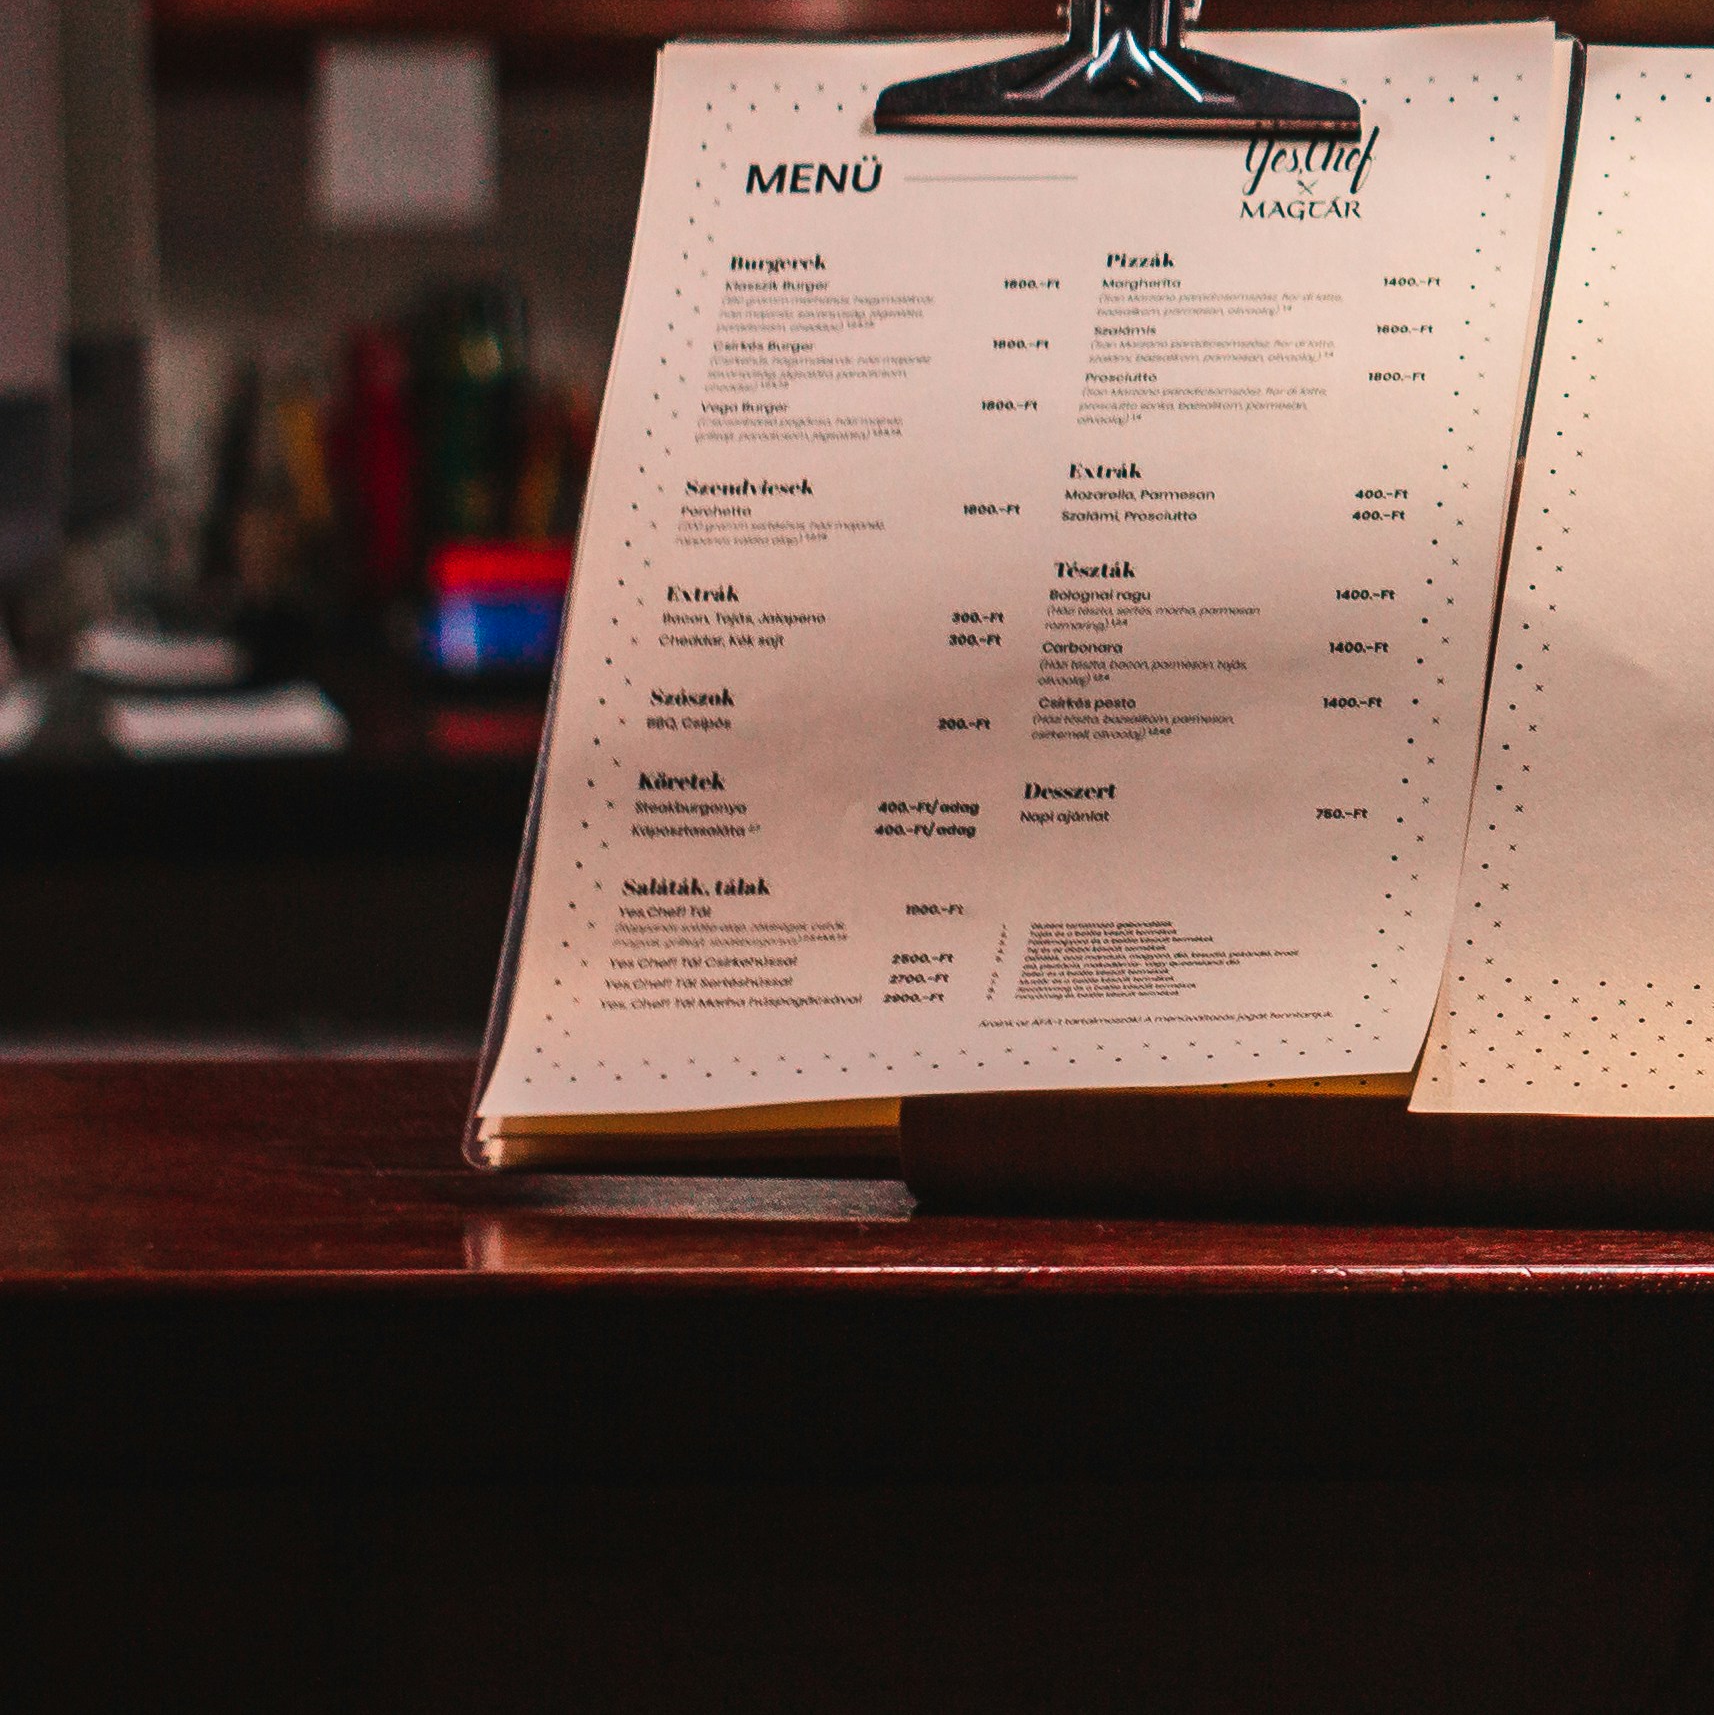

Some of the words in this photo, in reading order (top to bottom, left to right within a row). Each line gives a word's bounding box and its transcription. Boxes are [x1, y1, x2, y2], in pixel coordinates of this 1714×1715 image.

[745, 155, 883, 195] MENÜ
[1240, 196, 1361, 221] MAGTÁR
[730, 253, 826, 274] Burgerek
[1106, 252, 1174, 268] Pizzák
[1101, 277, 1182, 292] Margherita
[1383, 276, 1441, 287] 1400.-Ft
[1093, 325, 1157, 337] Szalámis
[767, 340, 814, 355] Burger
[1084, 372, 1158, 384] Prosciutto
[1368, 371, 1426, 382] 1800.-Ft
[741, 401, 789, 416] Burger
[1069, 462, 1142, 479] Extrák
[1139, 488, 1216, 501] Parmesan
[1354, 488, 1409, 500] 400.-Ft
[1061, 510, 1121, 523] Szalámi,
[1123, 510, 1198, 522] Prosciutto
[1351, 509, 1406, 521] 400.-Ft
[1054, 560, 1136, 579] Tészták
[666, 584, 740, 603] Extrák
[1048, 588, 1114, 604] Bolognai
[1115, 590, 1152, 604] ragu
[1335, 588, 1396, 601] 1400.-Ft
[1041, 641, 1124, 655] Carbonara
[1328, 641, 1389, 654] 1400.-Ft
[1038, 696, 1092, 710] Csirkés
[1093, 697, 1137, 713] pesto
[1322, 696, 1383, 709] 1400.-Ft
[638, 771, 725, 791] Köretek
[1023, 782, 1117, 800] Desszert
[1019, 810, 1055, 826] Napi
[1056, 810, 1110, 826] ajánlat
[714, 876, 771, 897] tálak
